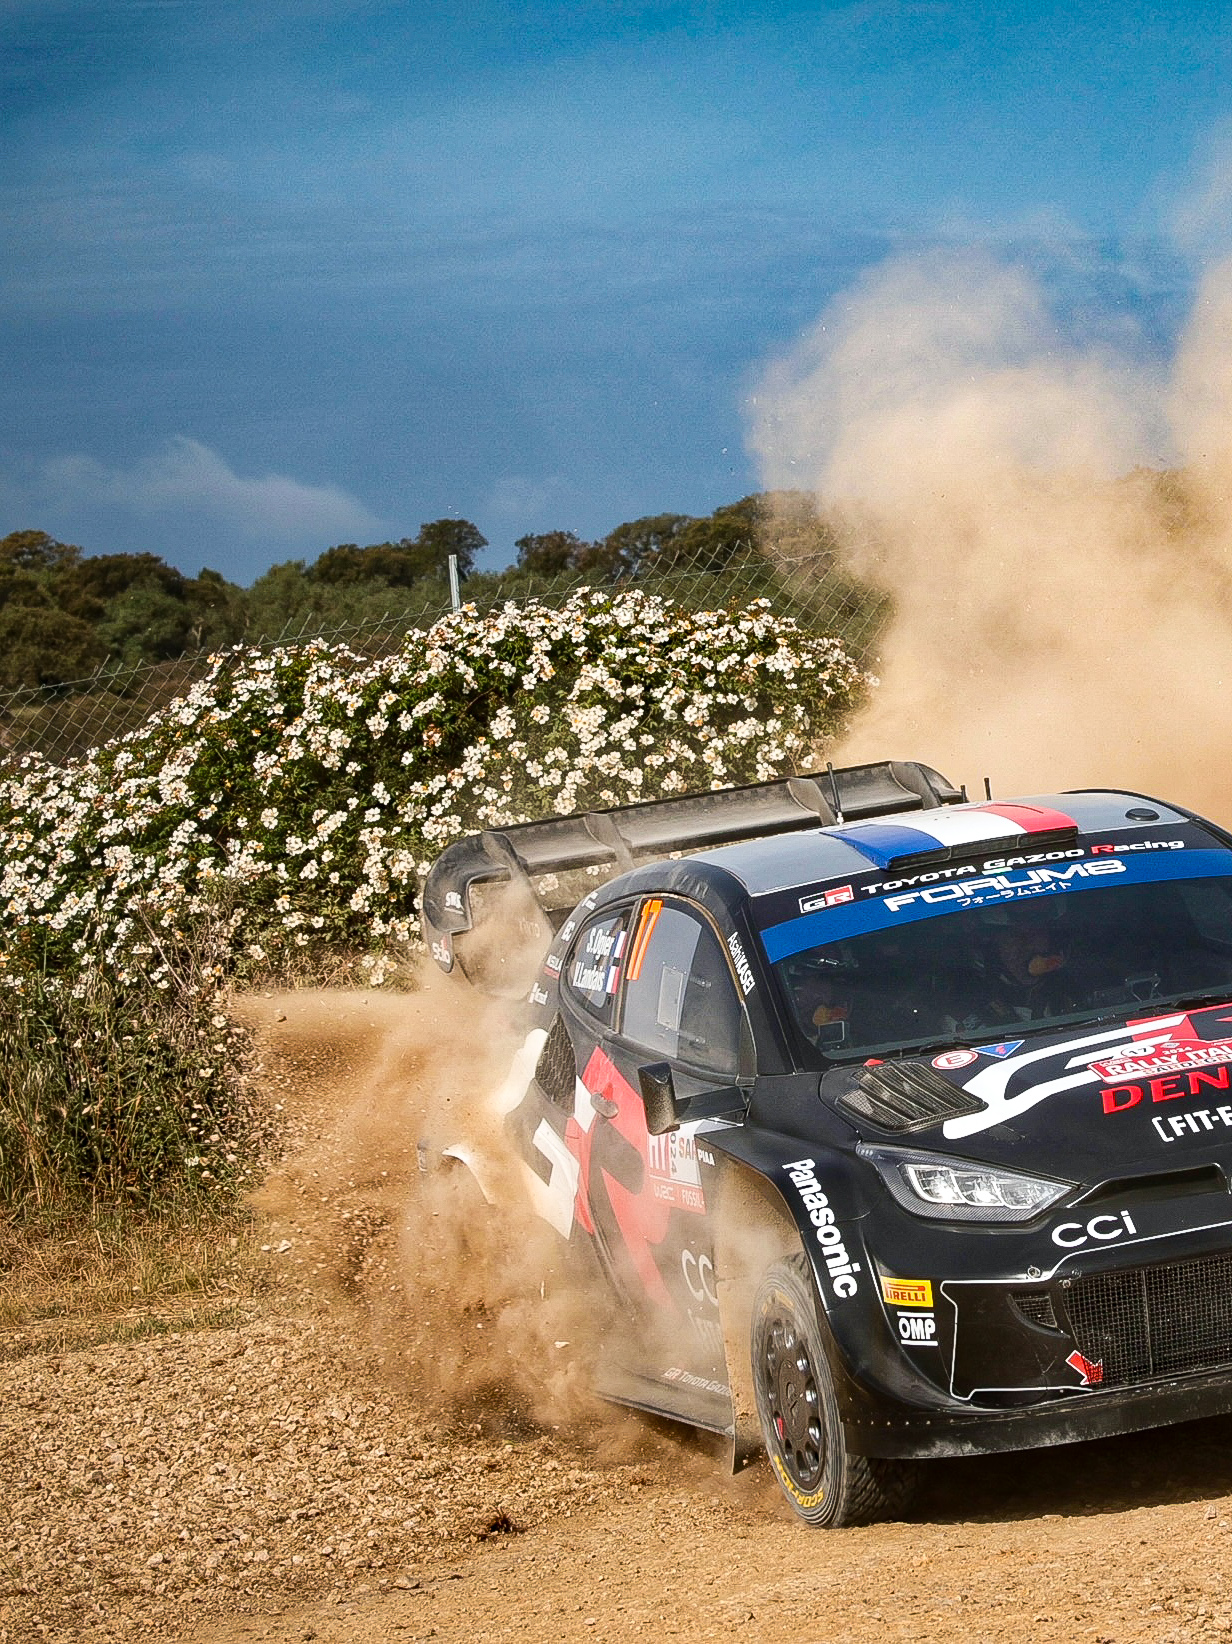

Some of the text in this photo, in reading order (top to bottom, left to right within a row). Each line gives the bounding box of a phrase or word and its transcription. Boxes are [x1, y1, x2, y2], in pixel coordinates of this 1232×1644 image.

[802, 840, 1185, 912] GR TOYOTA GAZOO Racing
[883, 859, 1127, 912] FORUM8
[957, 881, 1072, 907] フォーラムエイト
[626, 899, 663, 980] 17
[1105, 1054, 1178, 1076] RALLY
[782, 1158, 861, 1299] Panasonic
[884, 1283, 926, 1302] PIRELLI
[898, 1317, 936, 1340] OMP
